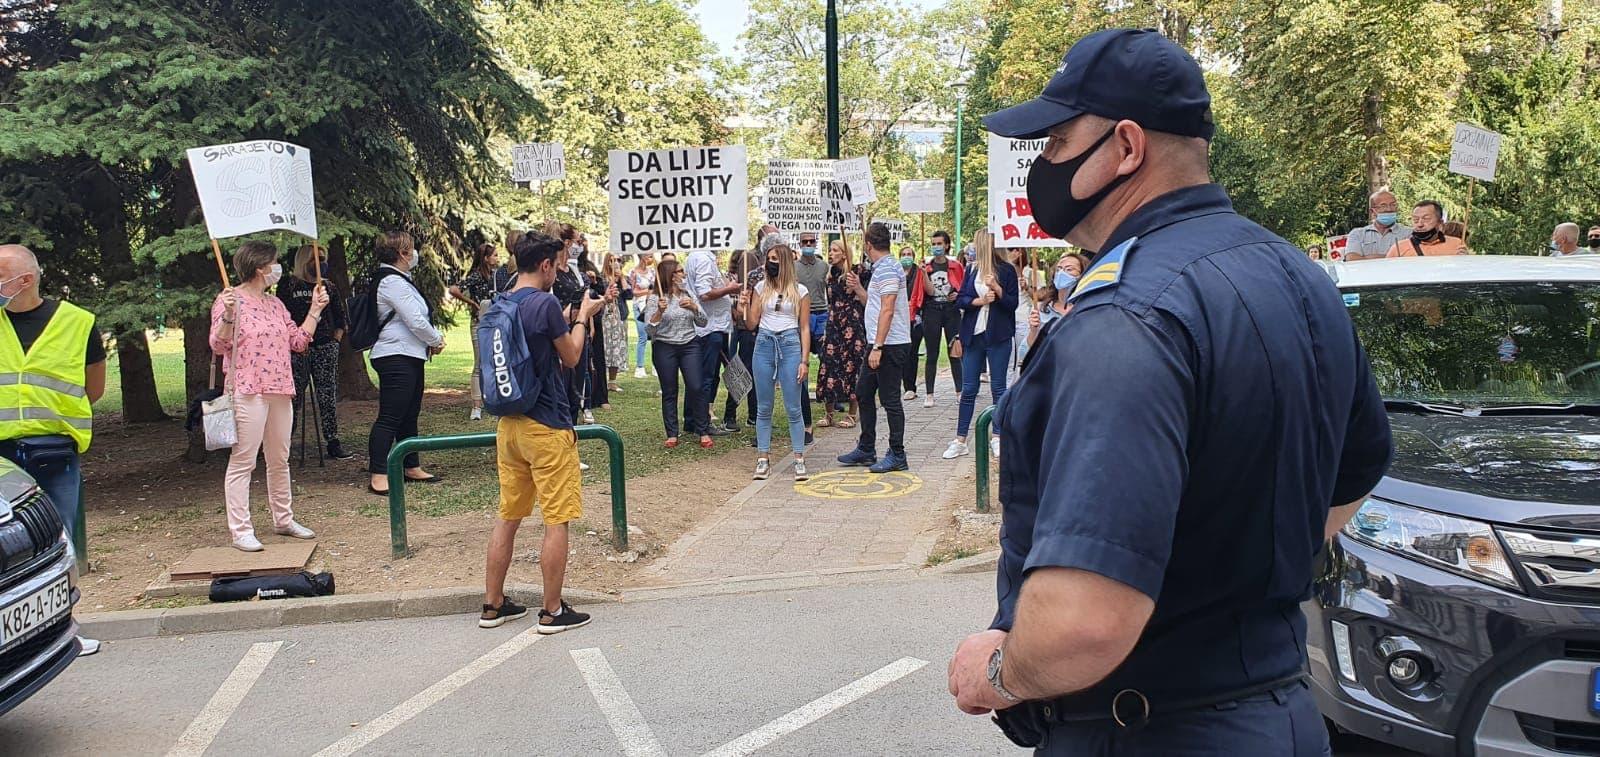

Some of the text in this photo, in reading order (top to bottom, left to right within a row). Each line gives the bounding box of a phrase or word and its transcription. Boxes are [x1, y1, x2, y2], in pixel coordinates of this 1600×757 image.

[203, 141, 285, 163] SARAJEVO
[1010, 140, 1045, 152] KRIVI
[535, 157, 563, 178] RAD
[628, 148, 722, 173] DA LI JE
[769, 170, 784, 178] RAD
[618, 174, 732, 200] SECURITY
[769, 178, 794, 187] LJUDI
[795, 178, 809, 188] OD
[769, 187, 817, 196] AUSTRALIJE
[768, 204, 794, 212] CENTAR
[830, 199, 842, 211] NA
[269, 212, 298, 226] BiH
[638, 202, 714, 226] IZNAD
[768, 212, 780, 220] OD
[782, 212, 804, 221] KOJIH
[803, 221, 820, 231] 100
[620, 227, 733, 252] POLICIJE?
[493, 328, 513, 397] adidas
[2, 579, 69, 640] K82-A-735
